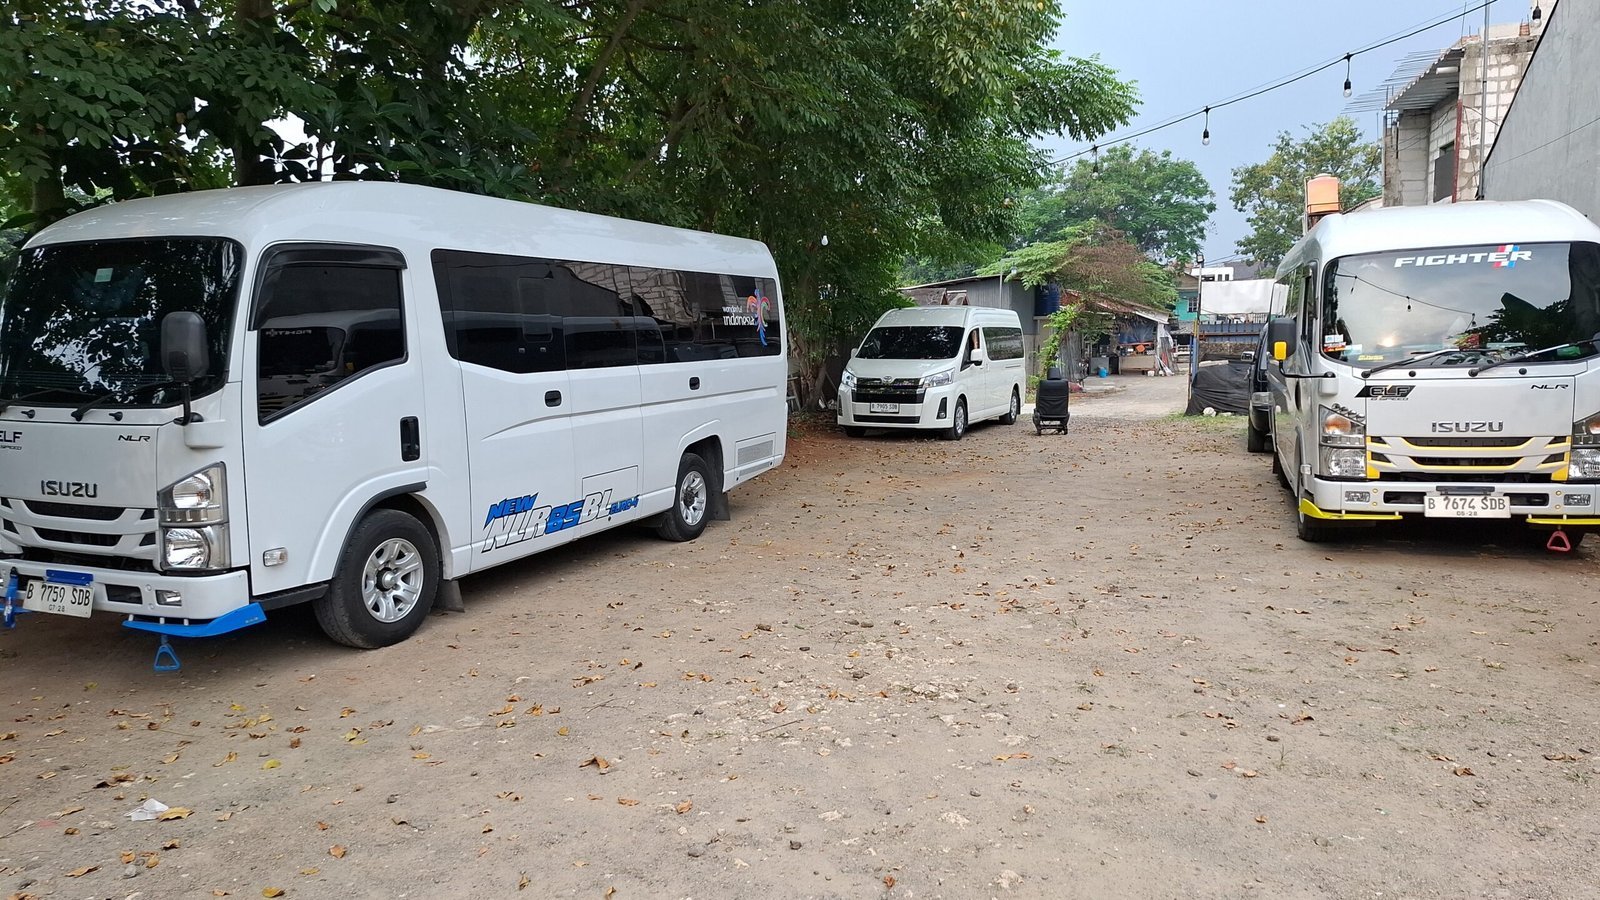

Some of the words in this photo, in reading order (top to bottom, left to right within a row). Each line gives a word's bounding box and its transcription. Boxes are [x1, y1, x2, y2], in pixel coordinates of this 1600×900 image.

[1394, 250, 1532, 268] FIGHTER
[1370, 386, 1410, 397] ELF
[1431, 421, 1504, 433] ISUZU
[118, 434, 151, 442] NLR
[41, 479, 98, 499] ISUZU
[483, 492, 539, 530] NEW
[1428, 498, 1436, 509] B
[1443, 497, 1476, 510] 7674
[1481, 497, 1506, 510] SDB
[27, 583, 35, 599] B
[41, 584, 66, 603] 7759
[71, 587, 91, 606] SDB
